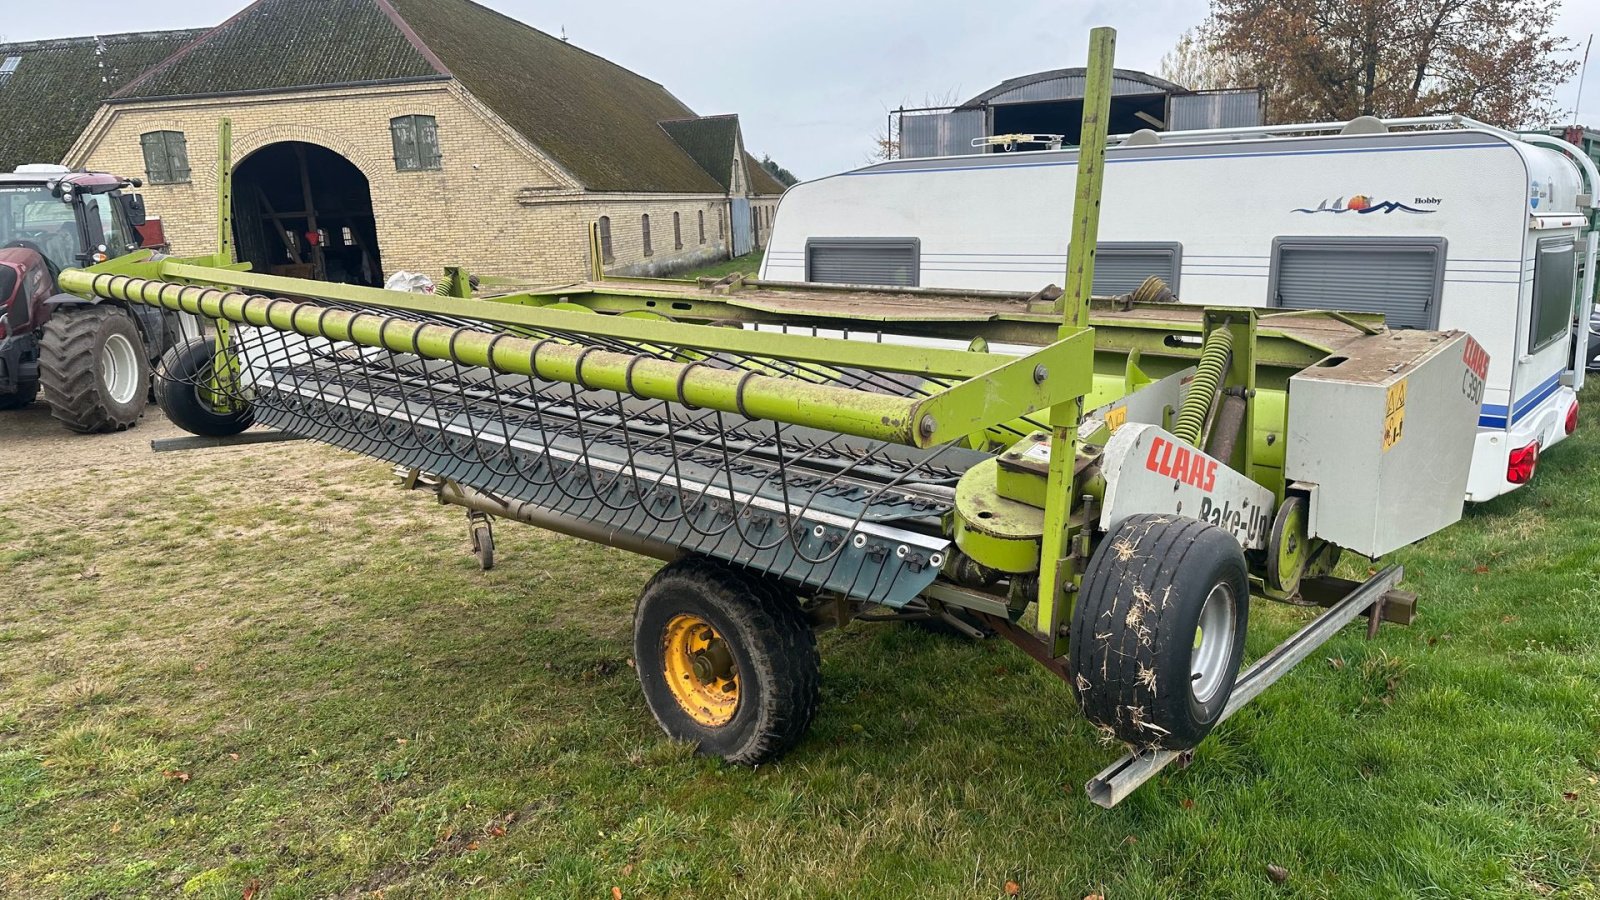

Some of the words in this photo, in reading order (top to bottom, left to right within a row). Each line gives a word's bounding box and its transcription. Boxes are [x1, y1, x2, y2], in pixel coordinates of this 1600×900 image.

[1414, 197, 1442, 205] Hobby
[1462, 335, 1490, 381] CLAAS
[1146, 436, 1218, 493] CLAAS
